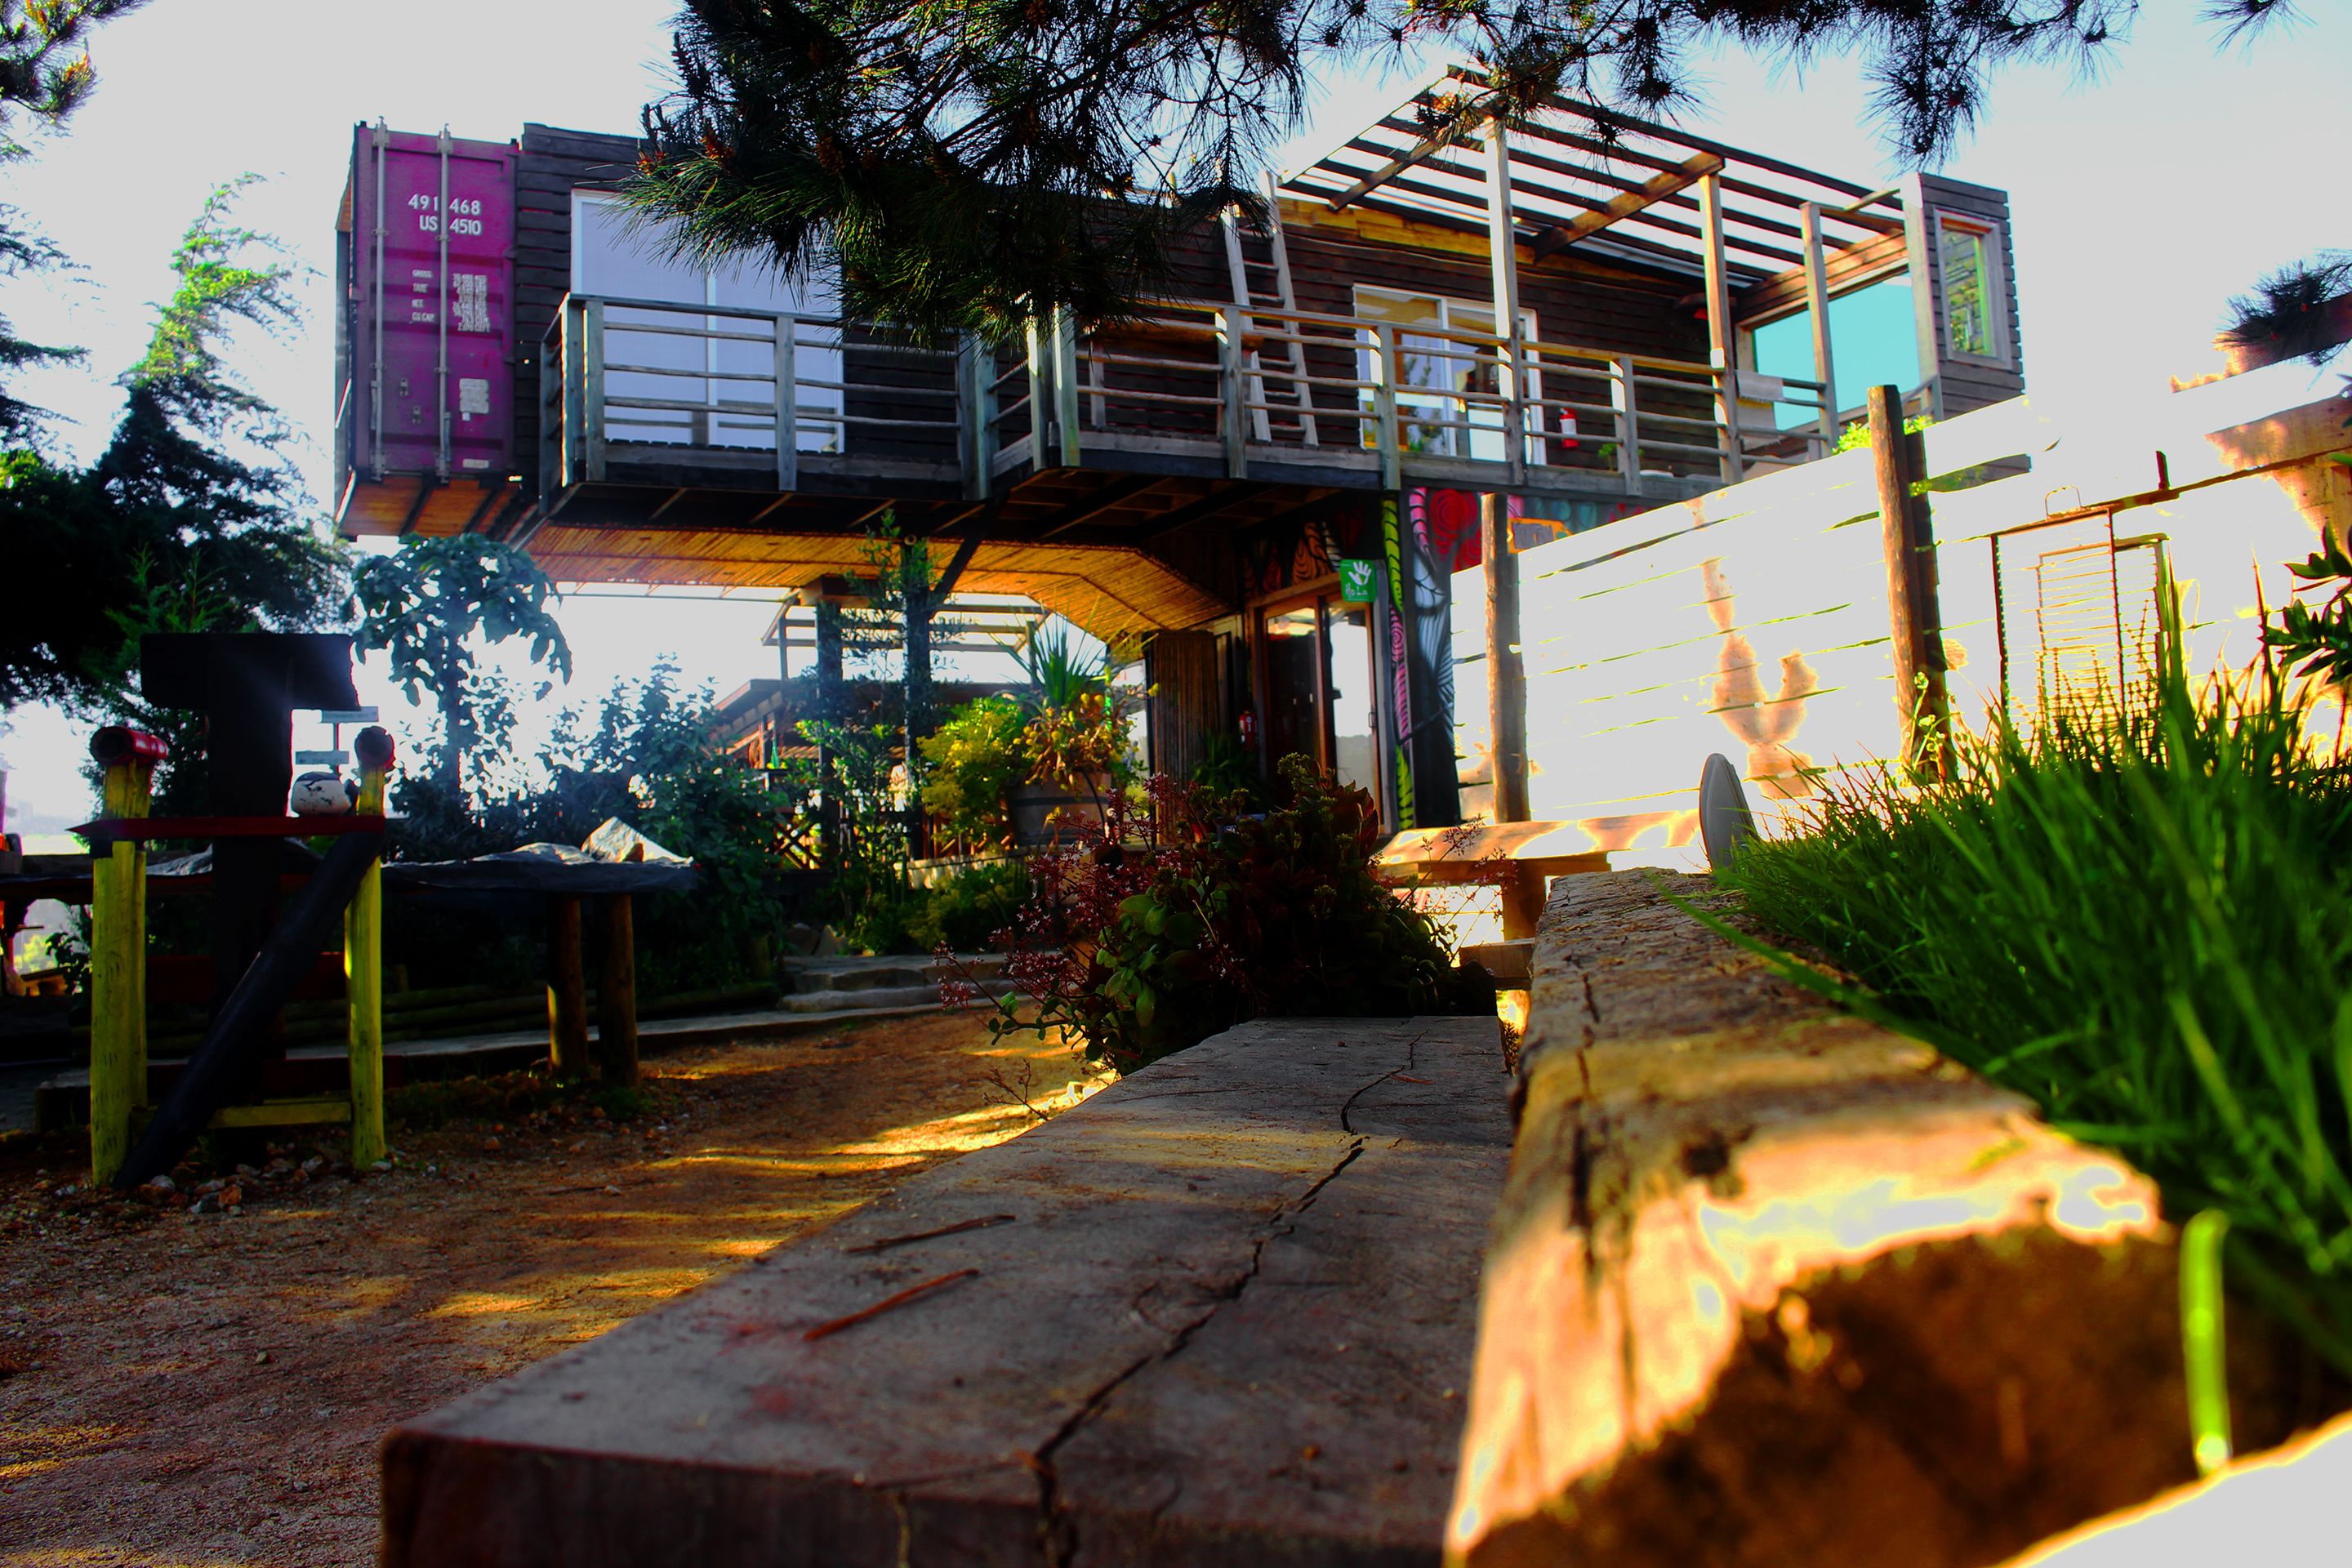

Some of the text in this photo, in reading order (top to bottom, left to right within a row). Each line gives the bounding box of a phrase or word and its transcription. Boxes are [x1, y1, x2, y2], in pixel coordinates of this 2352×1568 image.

[408, 194, 481, 216] 491 468
[419, 214, 482, 235] US 4510
